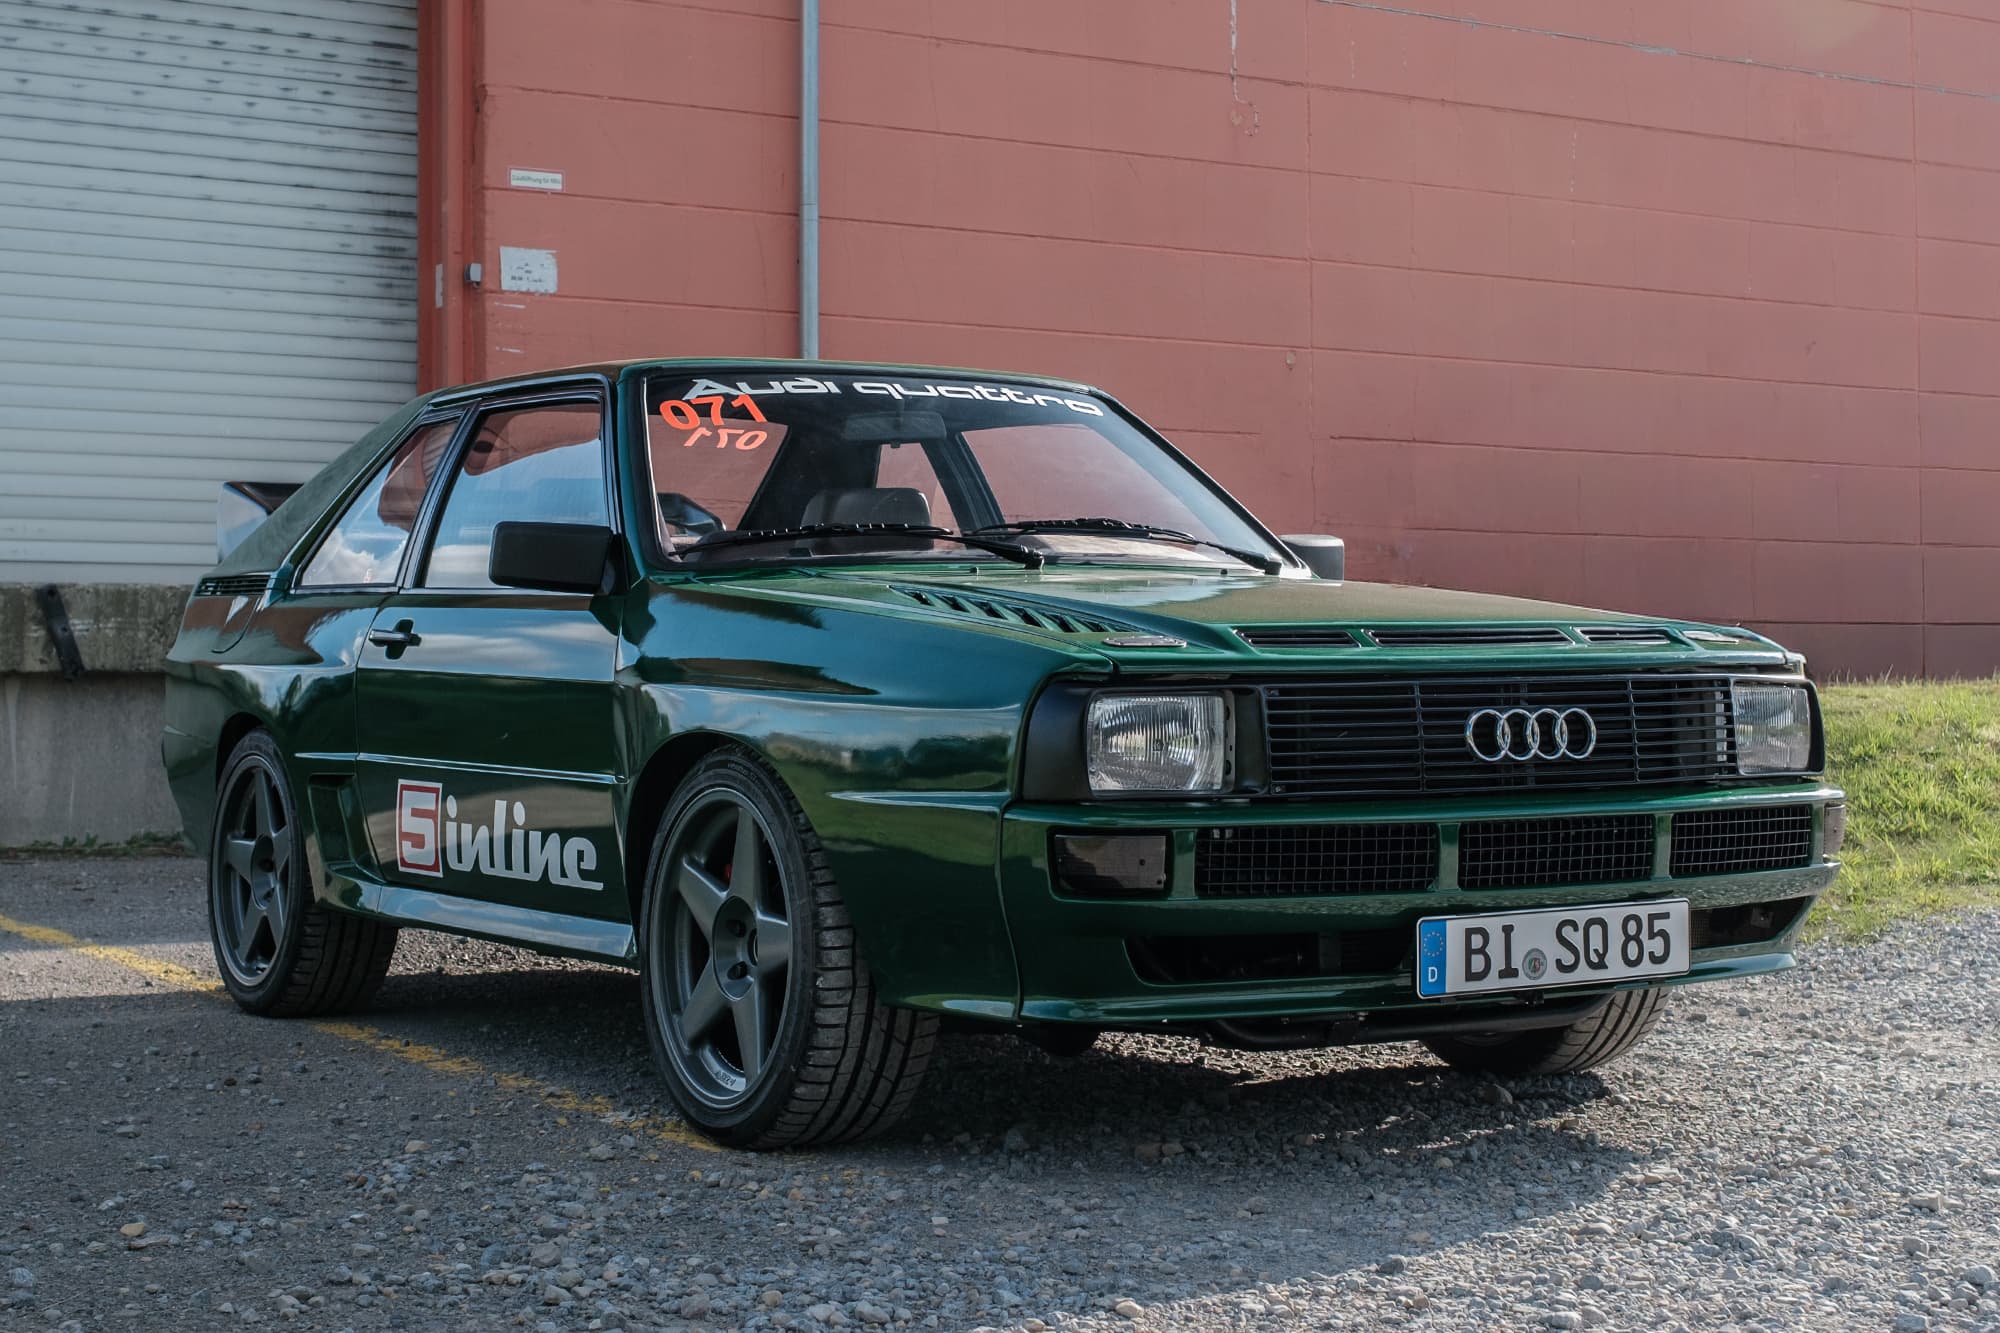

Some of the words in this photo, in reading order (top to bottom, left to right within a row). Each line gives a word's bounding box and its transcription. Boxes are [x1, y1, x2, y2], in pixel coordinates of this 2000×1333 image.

[659, 393, 768, 430] 071
[682, 377, 842, 400] Audi
[852, 381, 1105, 417] quattro
[1427, 966, 1438, 983] D
[1464, 923, 1520, 982] BI
[1555, 917, 1609, 974] SQ
[1621, 911, 1671, 968] 85
